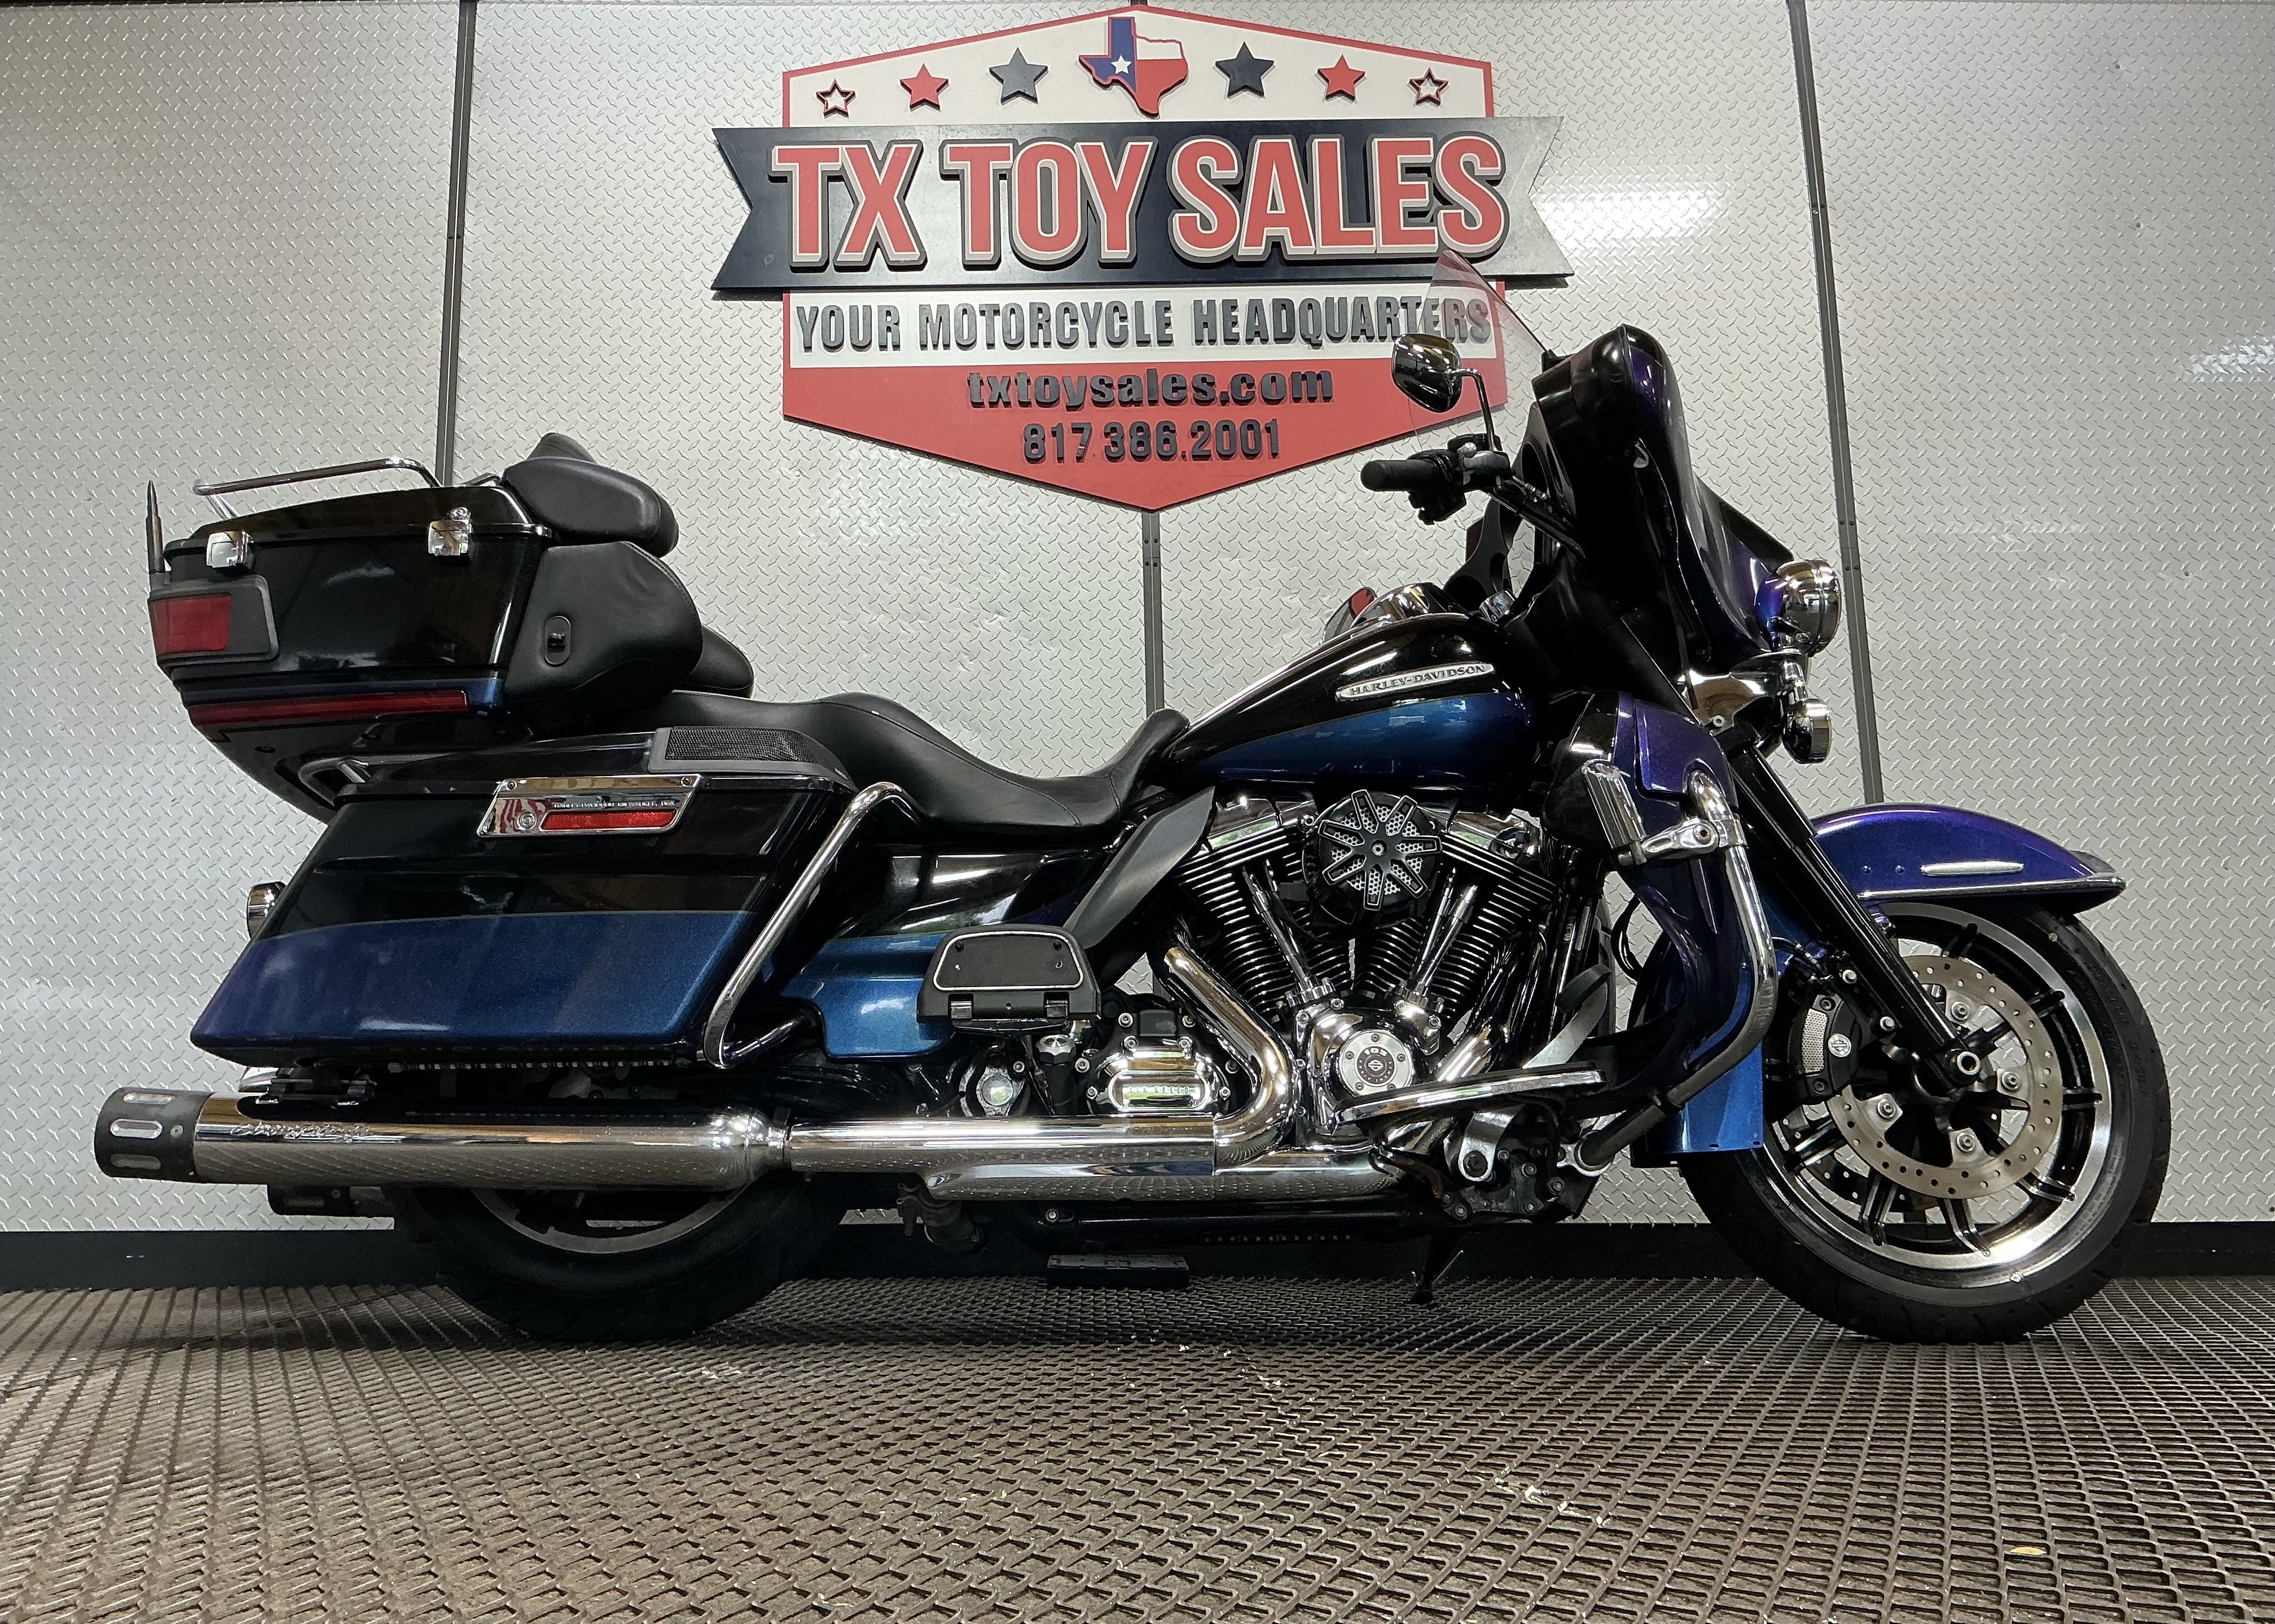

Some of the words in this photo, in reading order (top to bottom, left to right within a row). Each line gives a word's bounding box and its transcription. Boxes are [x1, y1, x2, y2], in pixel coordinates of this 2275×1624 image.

[770, 141, 925, 269] TX
[941, 138, 1156, 267] TOY
[1170, 134, 1507, 262] SALES
[796, 303, 901, 353] YOUR
[919, 301, 1173, 351] MOTORCYCLE
[1193, 295, 1491, 350] HEADQUARTERS
[967, 368, 1333, 411] txtoysales.com
[1349, 664, 1486, 696] HARLEY-DAVIDSON
